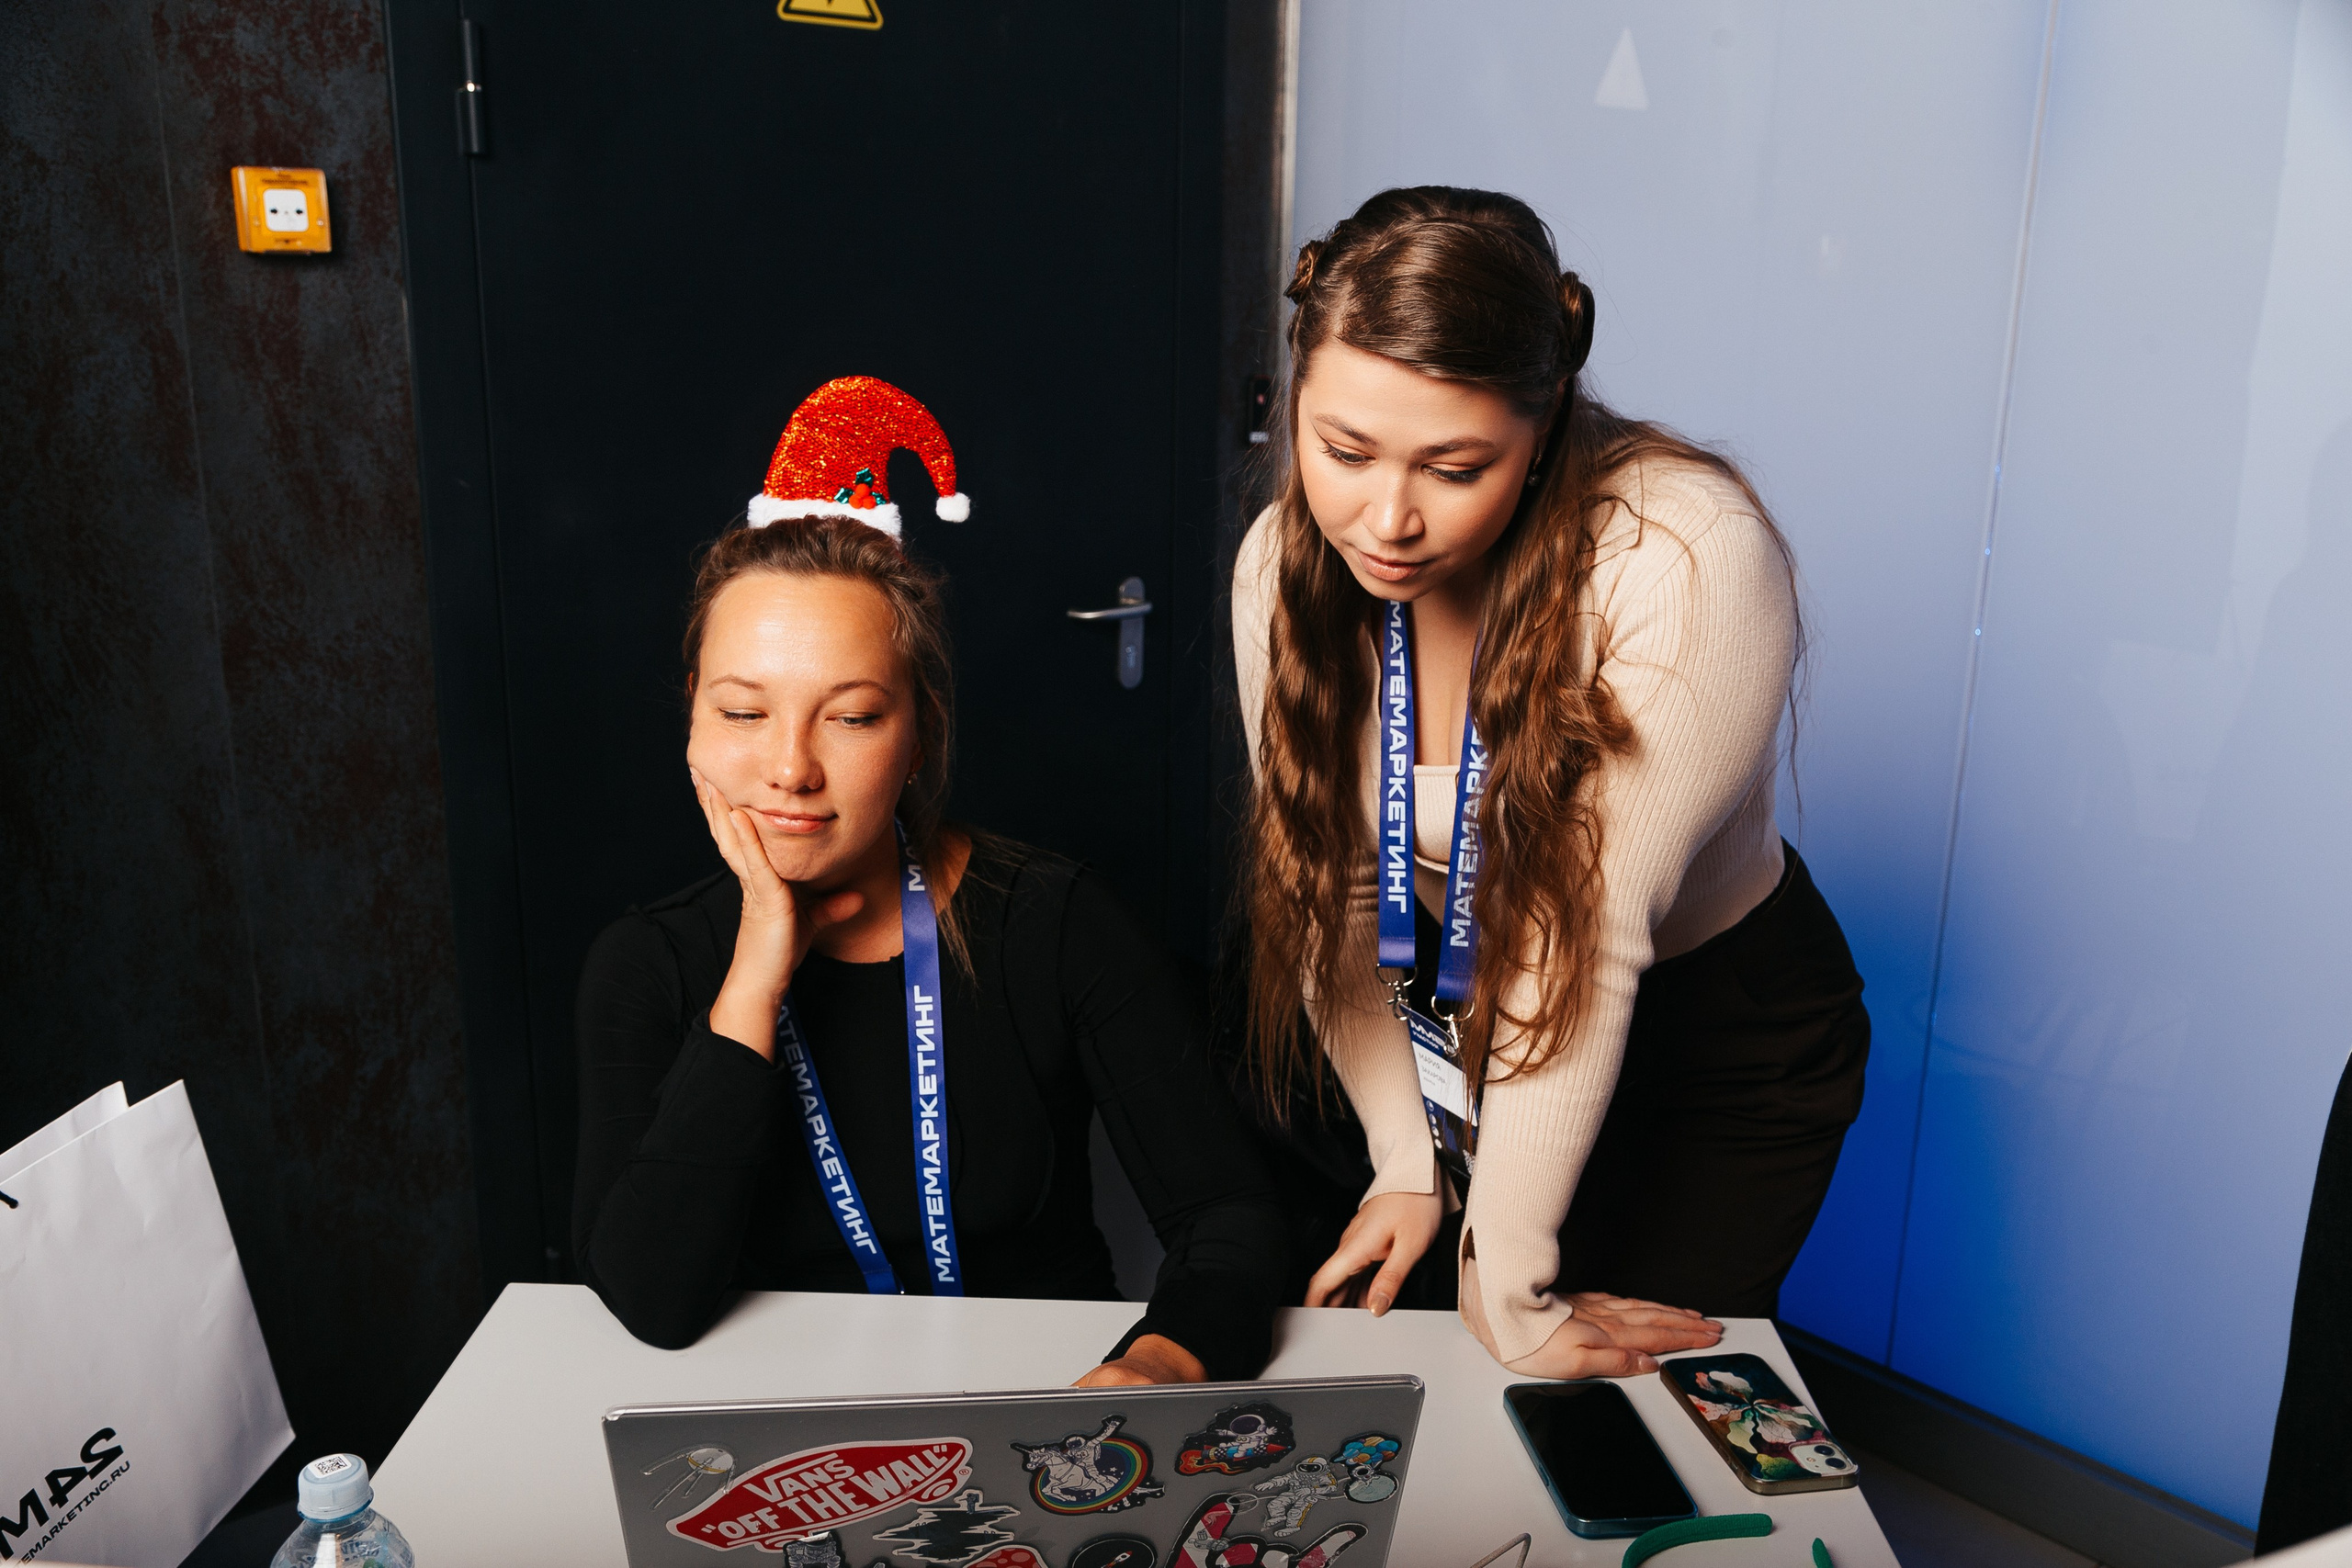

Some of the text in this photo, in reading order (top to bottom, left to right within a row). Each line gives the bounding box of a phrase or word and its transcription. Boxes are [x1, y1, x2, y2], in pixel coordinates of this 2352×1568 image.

[1387, 600, 1408, 913] МАТЕМАРКЕТИНГ
[777, 1005, 877, 1255] АТЕМАРКЕТИНГ
[913, 985, 955, 1282] МАТЕМАРКЕТИНГ
[16, 1461, 131, 1567] EMARKETING.RU
[742, 1452, 855, 1503] VANS
[777, 1481, 870, 1524] THE
